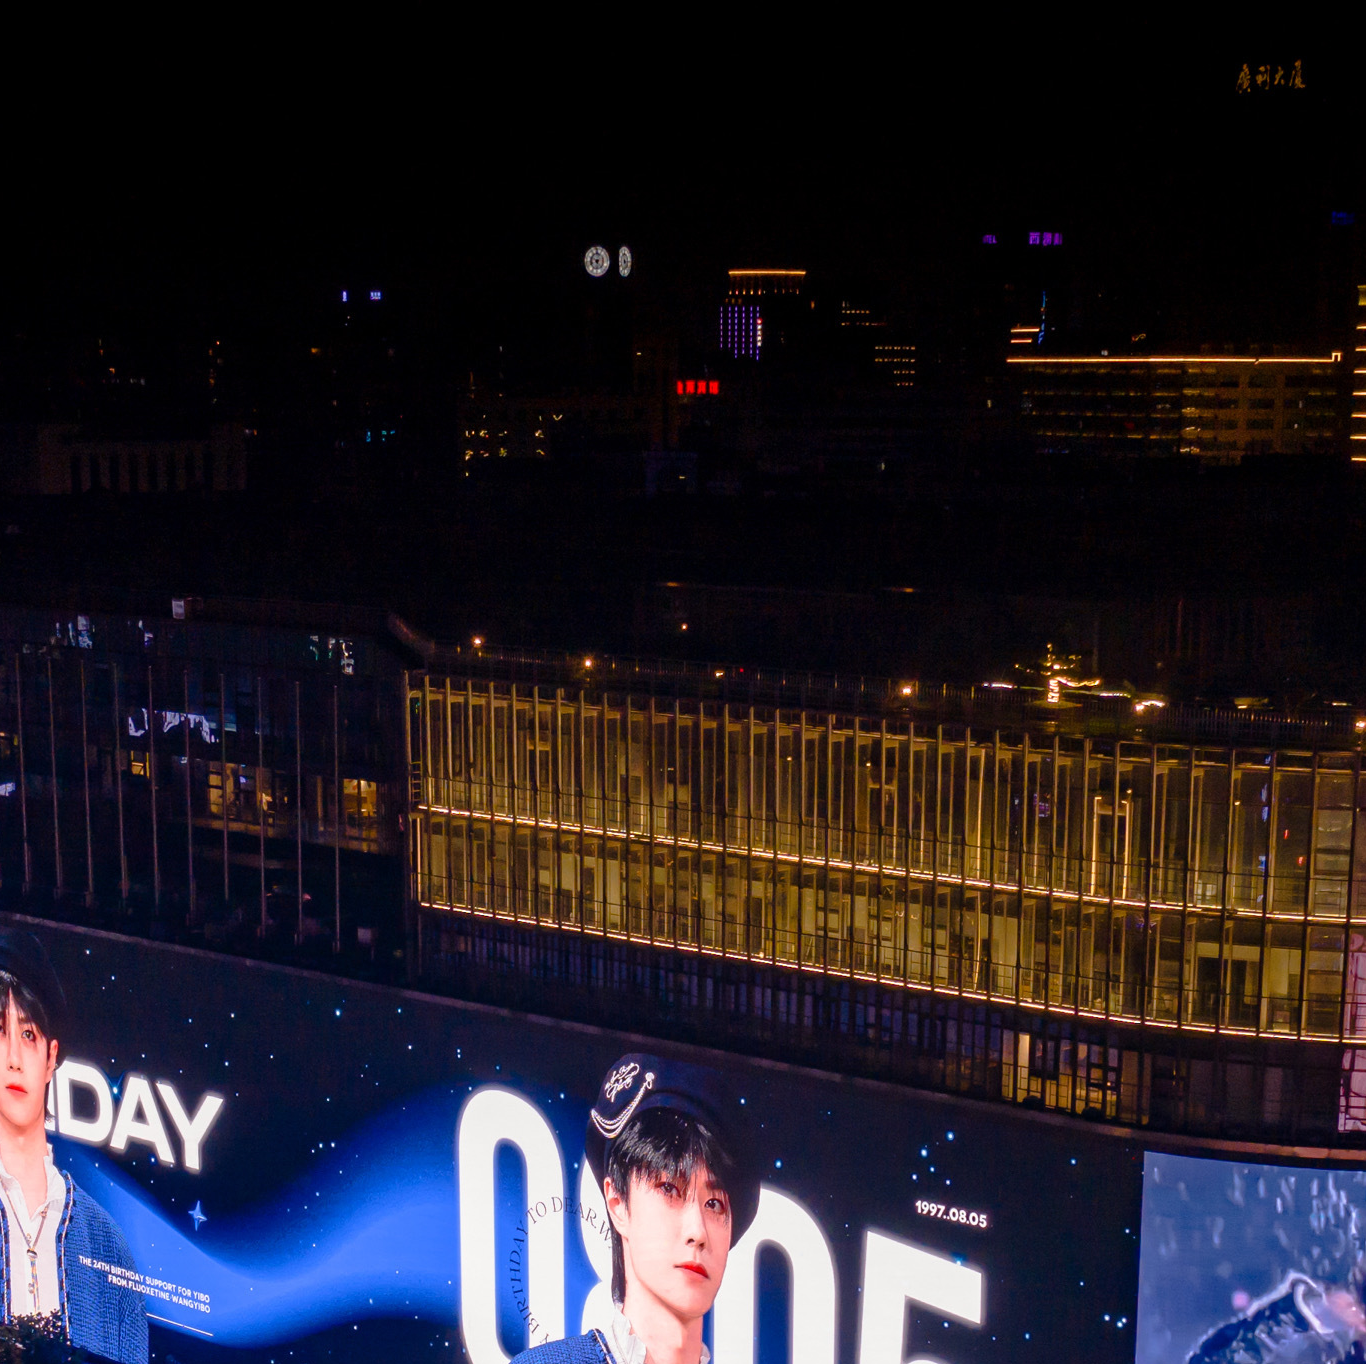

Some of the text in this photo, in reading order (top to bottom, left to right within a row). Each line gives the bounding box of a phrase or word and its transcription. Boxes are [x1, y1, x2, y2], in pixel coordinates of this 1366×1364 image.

[525, 1201, 548, 1225] TO
[551, 1195, 598, 1229] DEAR
[78, 1255, 211, 1304] THE 24TH BIRTHDAY SUPPORT FOR YIBO
